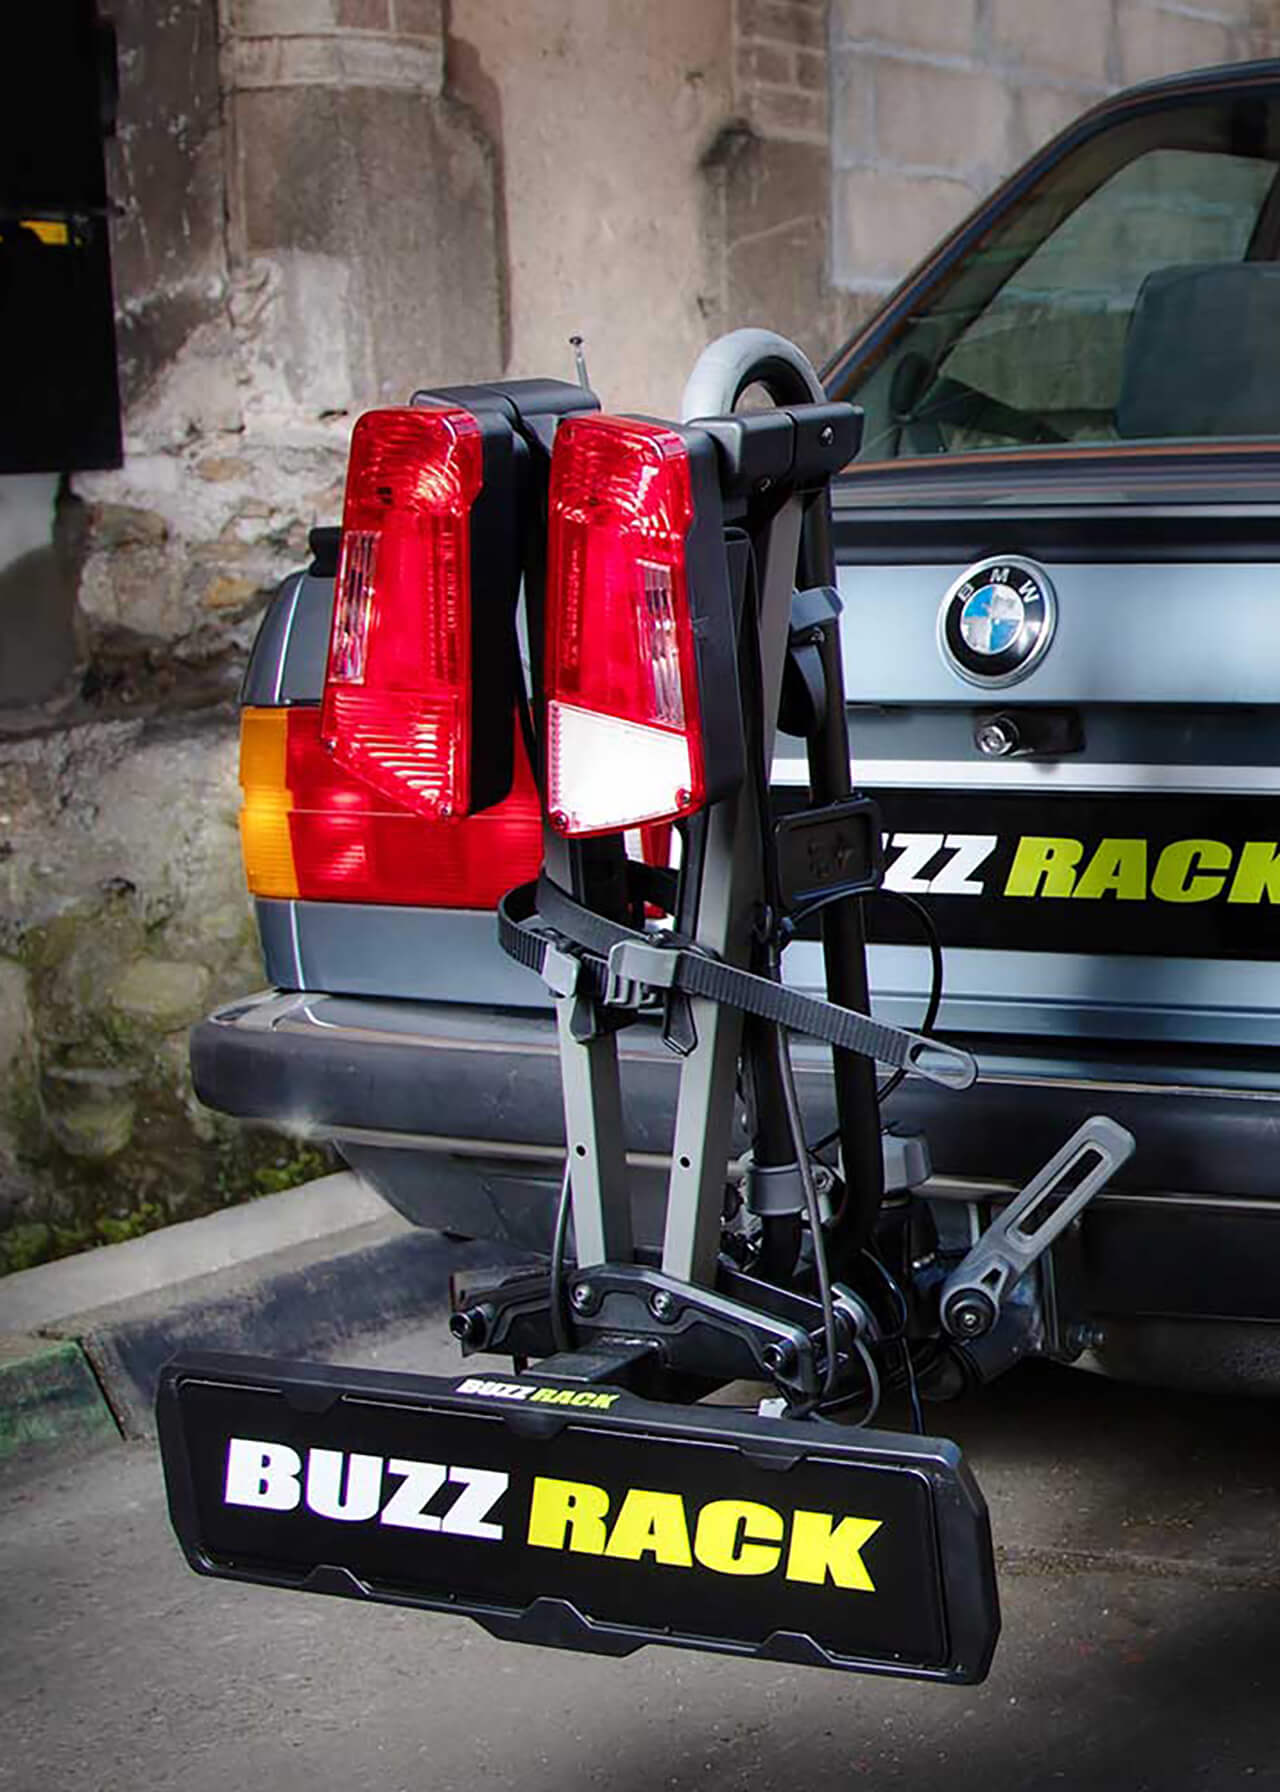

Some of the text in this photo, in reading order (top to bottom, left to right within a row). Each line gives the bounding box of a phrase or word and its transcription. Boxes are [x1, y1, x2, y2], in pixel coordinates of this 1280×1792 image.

[957, 566, 1040, 605] BMW
[455, 1378, 620, 1410] BUZZ RACK
[225, 1438, 883, 1593] BUZZ RACK
